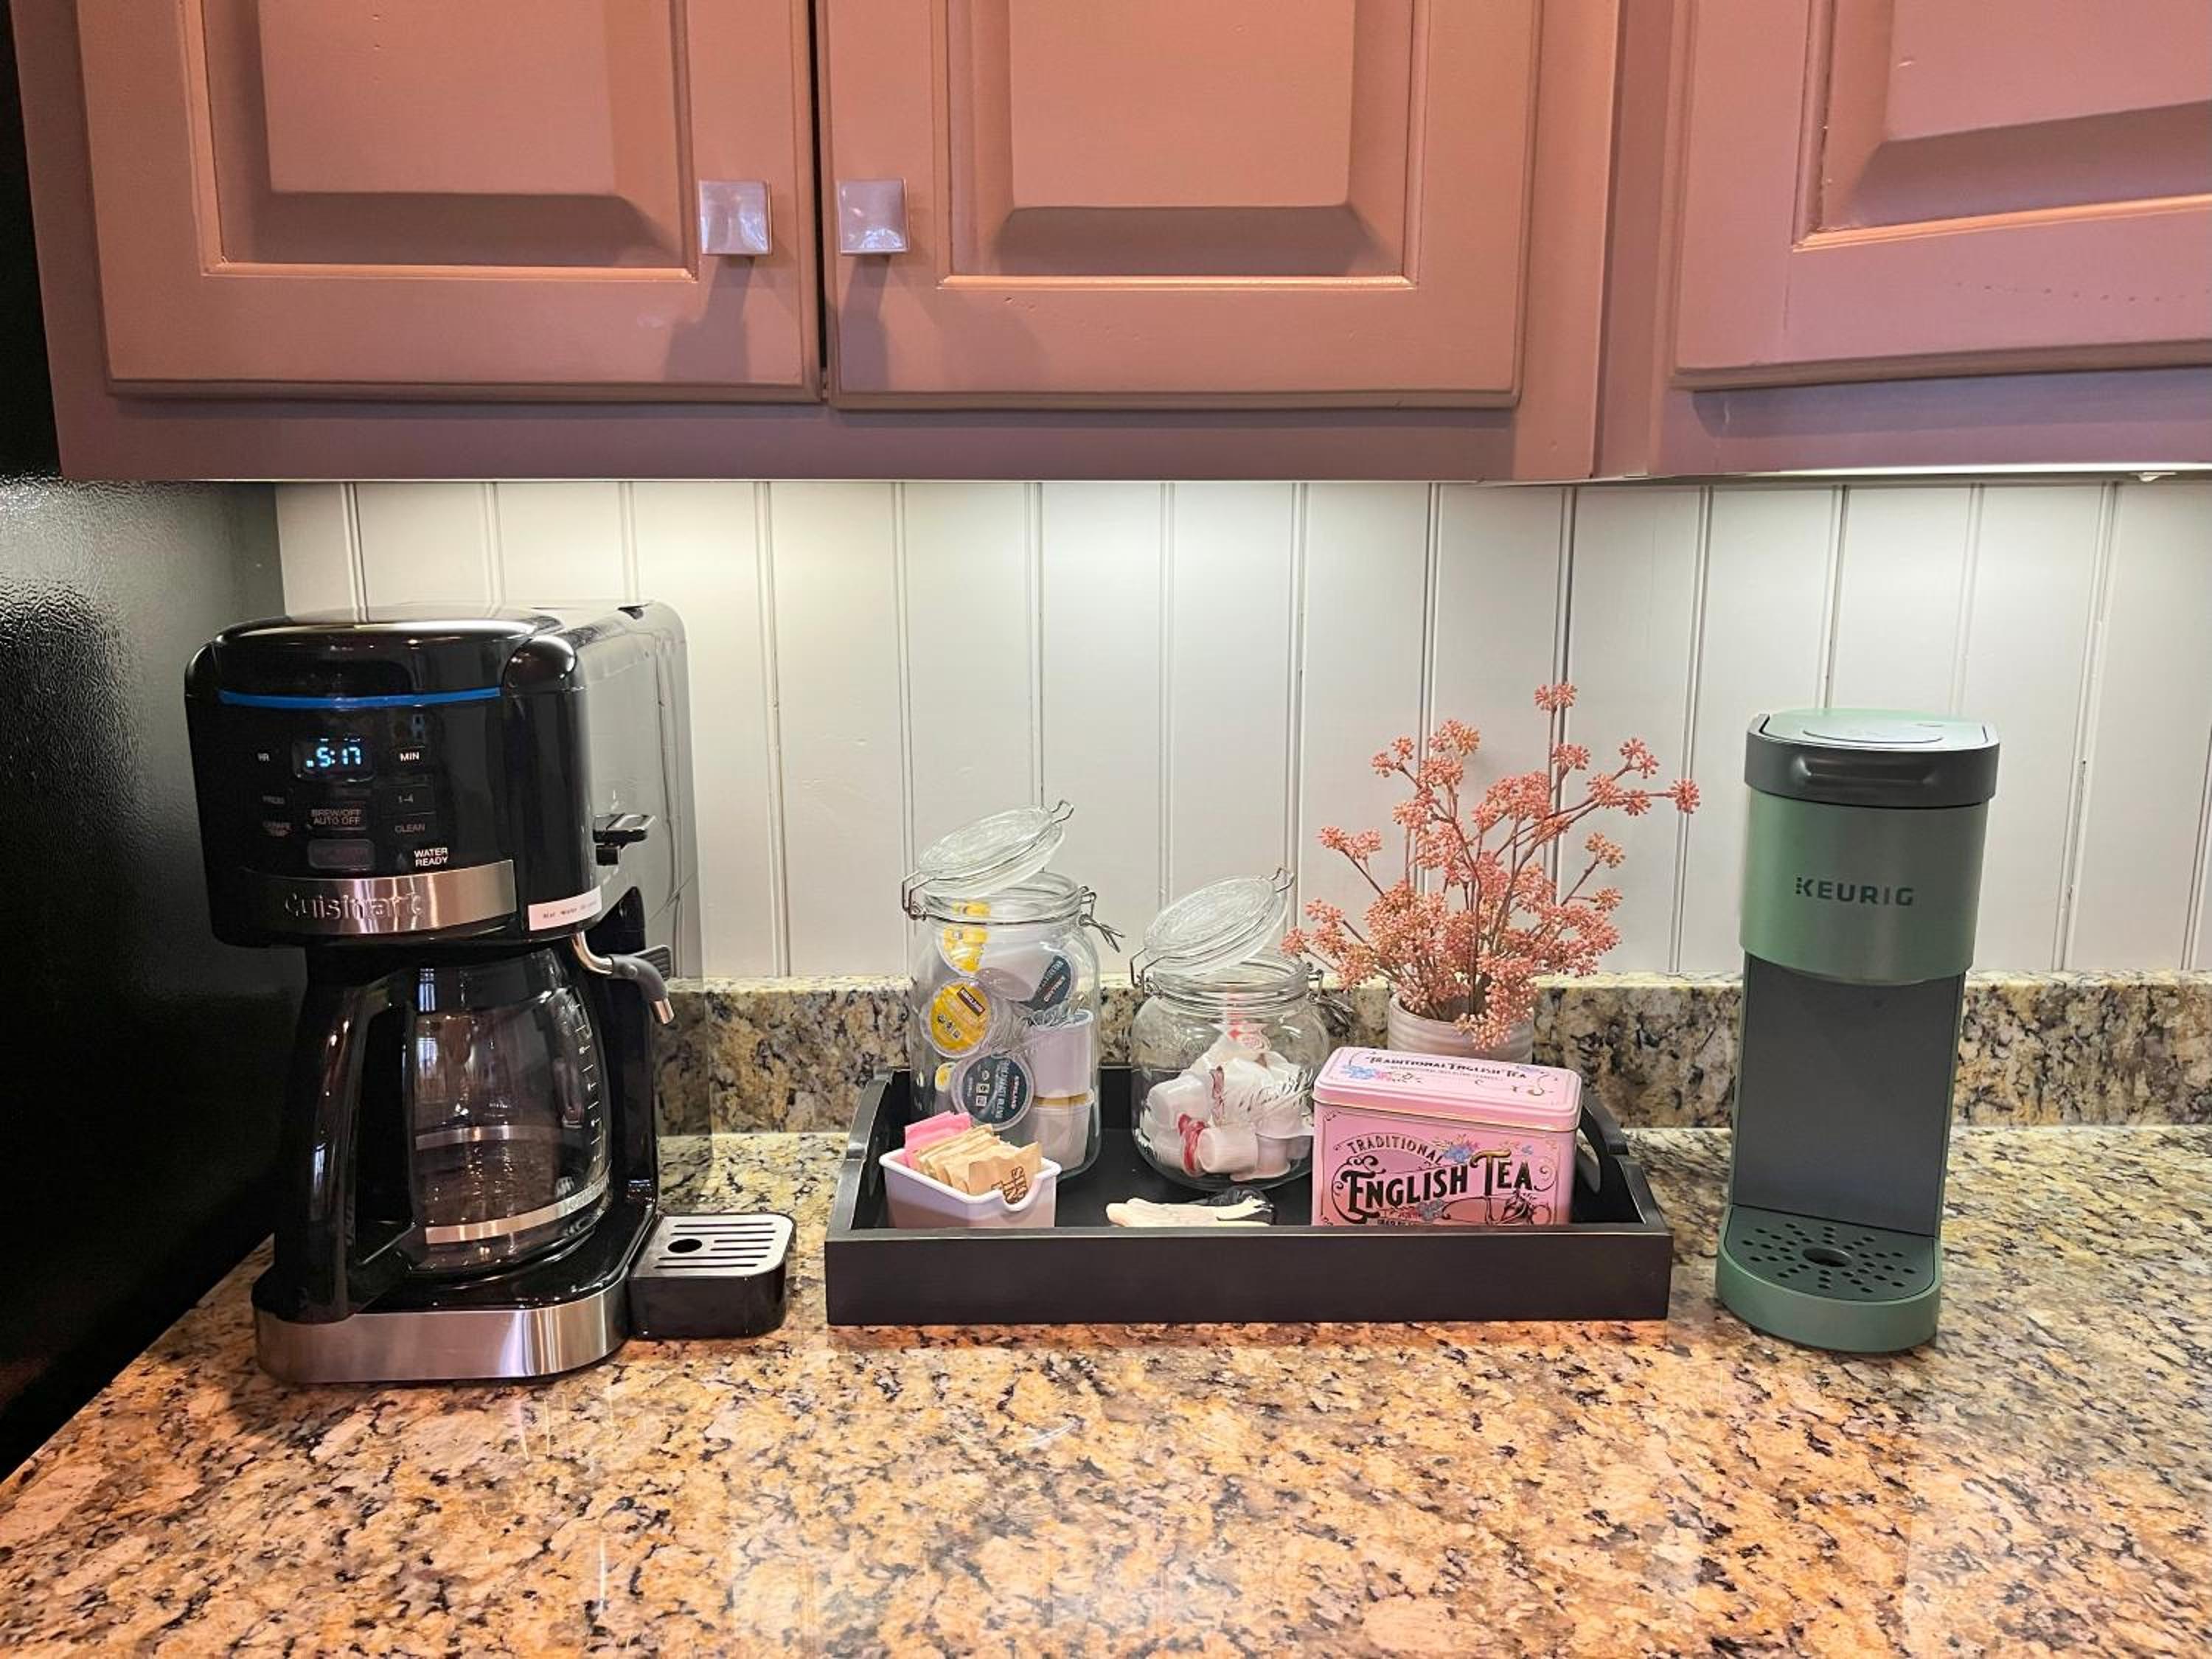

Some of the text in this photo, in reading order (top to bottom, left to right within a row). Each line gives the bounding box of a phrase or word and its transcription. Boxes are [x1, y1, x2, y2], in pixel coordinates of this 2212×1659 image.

[400, 751, 420, 762] MIN
[313, 816, 361, 825] AUTO OFF
[395, 824, 425, 833] CLEAN
[414, 847, 448, 858] WATER
[415, 856, 448, 867] READY
[1796, 877, 1914, 906] KEURIG
[285, 892, 422, 920] Cuisinart
[1369, 1056, 1448, 1069] TRADITIONAL
[1506, 1069, 1527, 1079] TEA
[1346, 1135, 1443, 1165] TRADITIONAL
[1340, 1148, 1534, 1219] ENGLISH TEA
